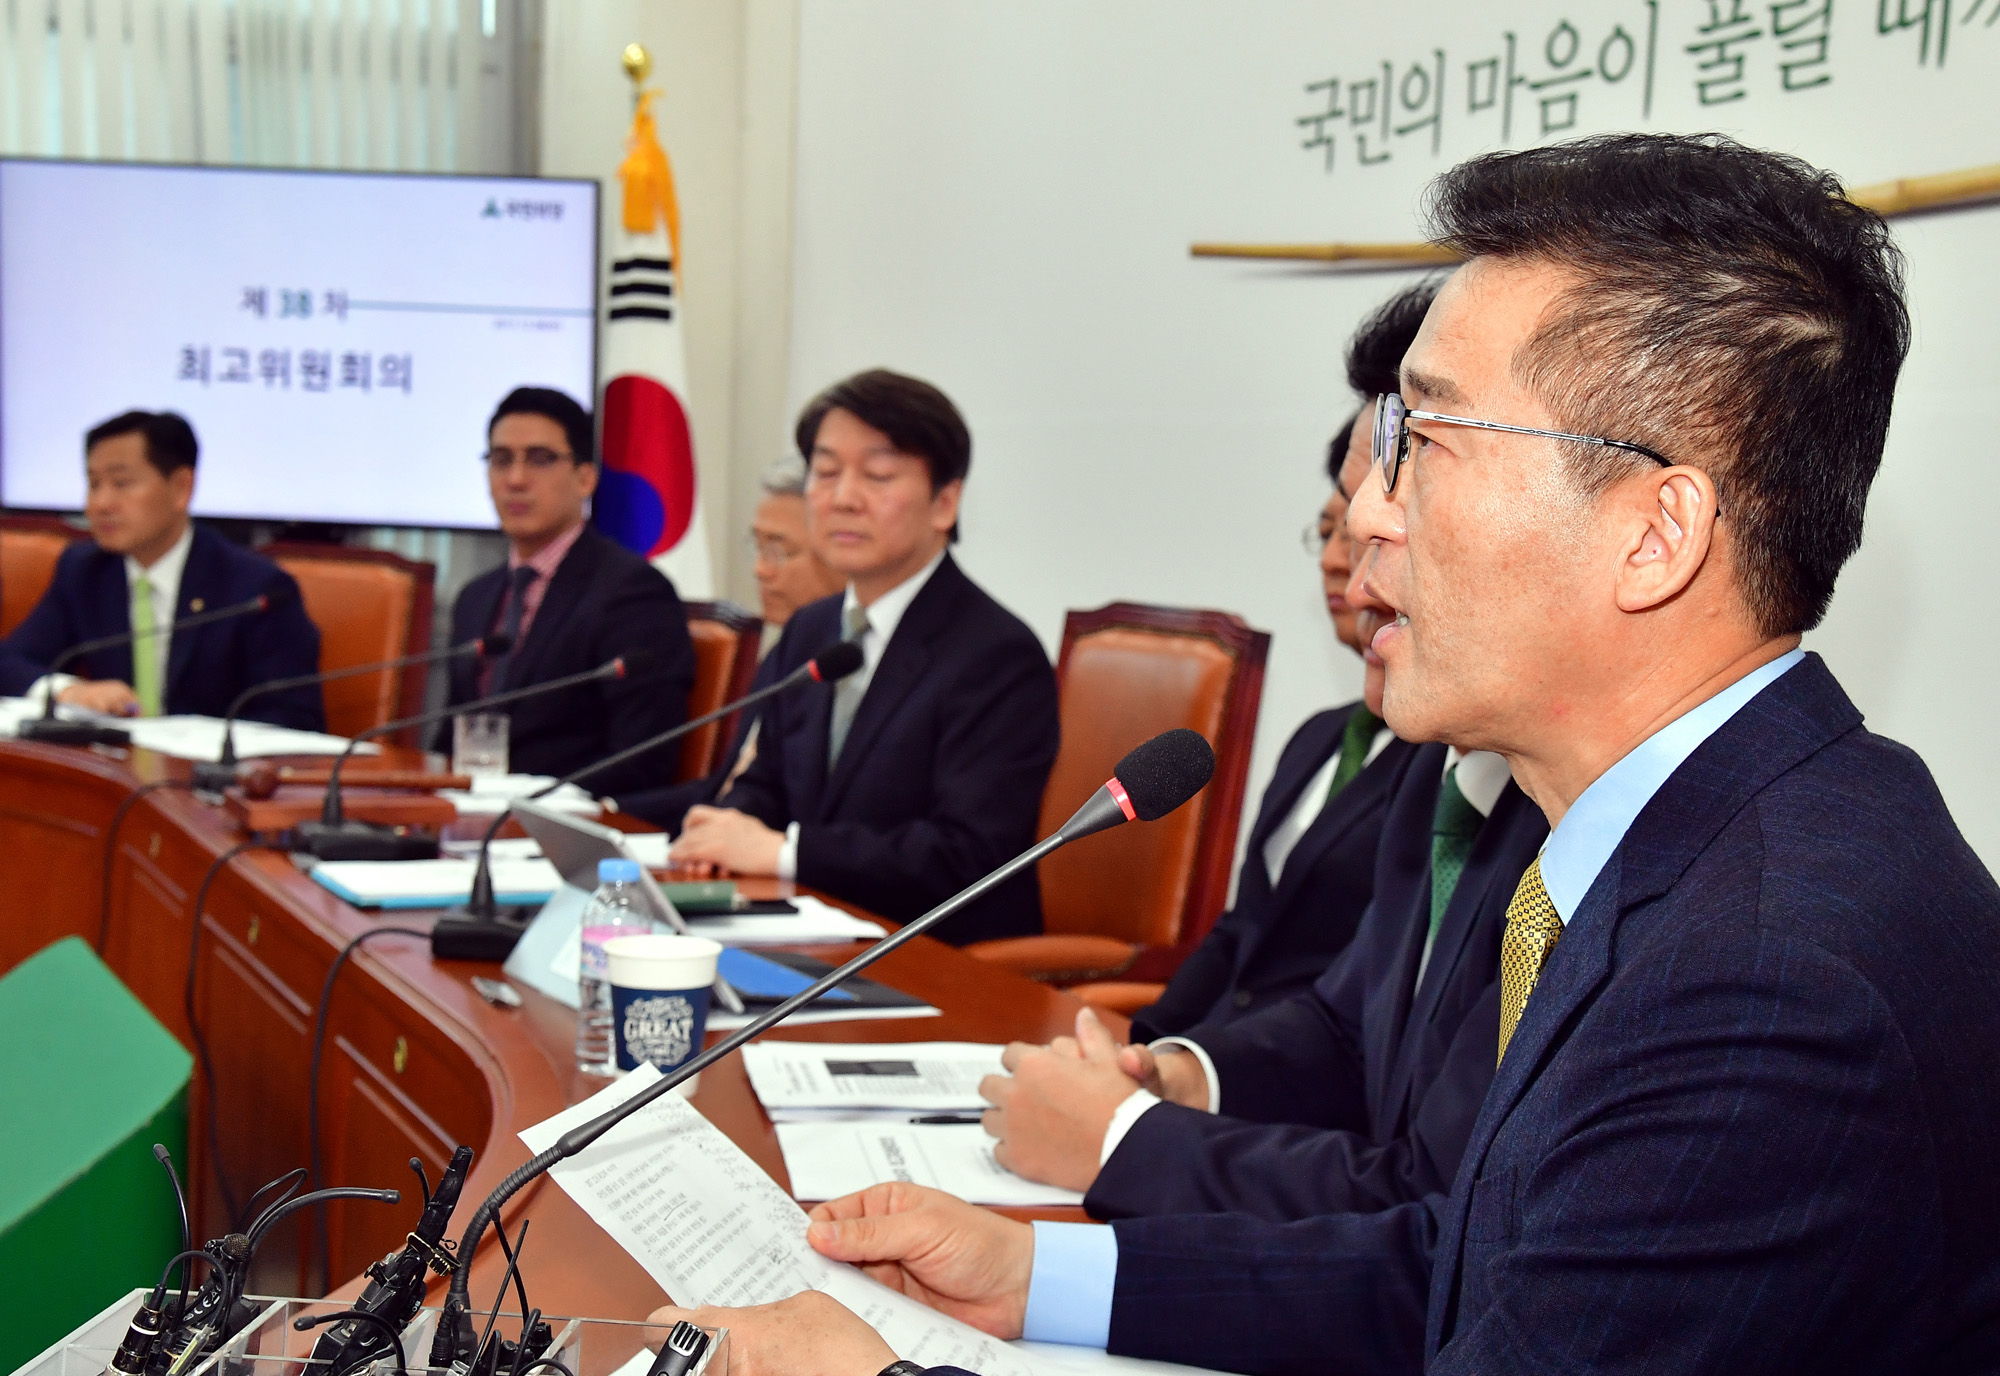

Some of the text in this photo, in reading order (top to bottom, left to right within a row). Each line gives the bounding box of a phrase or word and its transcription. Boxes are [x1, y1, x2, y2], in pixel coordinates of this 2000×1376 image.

[1296, 49, 1446, 174] 국민의
[1466, 0, 1659, 140] 마음이
[241, 286, 268, 319] 제
[321, 287, 348, 324] 차
[178, 343, 413, 394] 최고위원회의
[623, 1017, 694, 1042] GREAT
